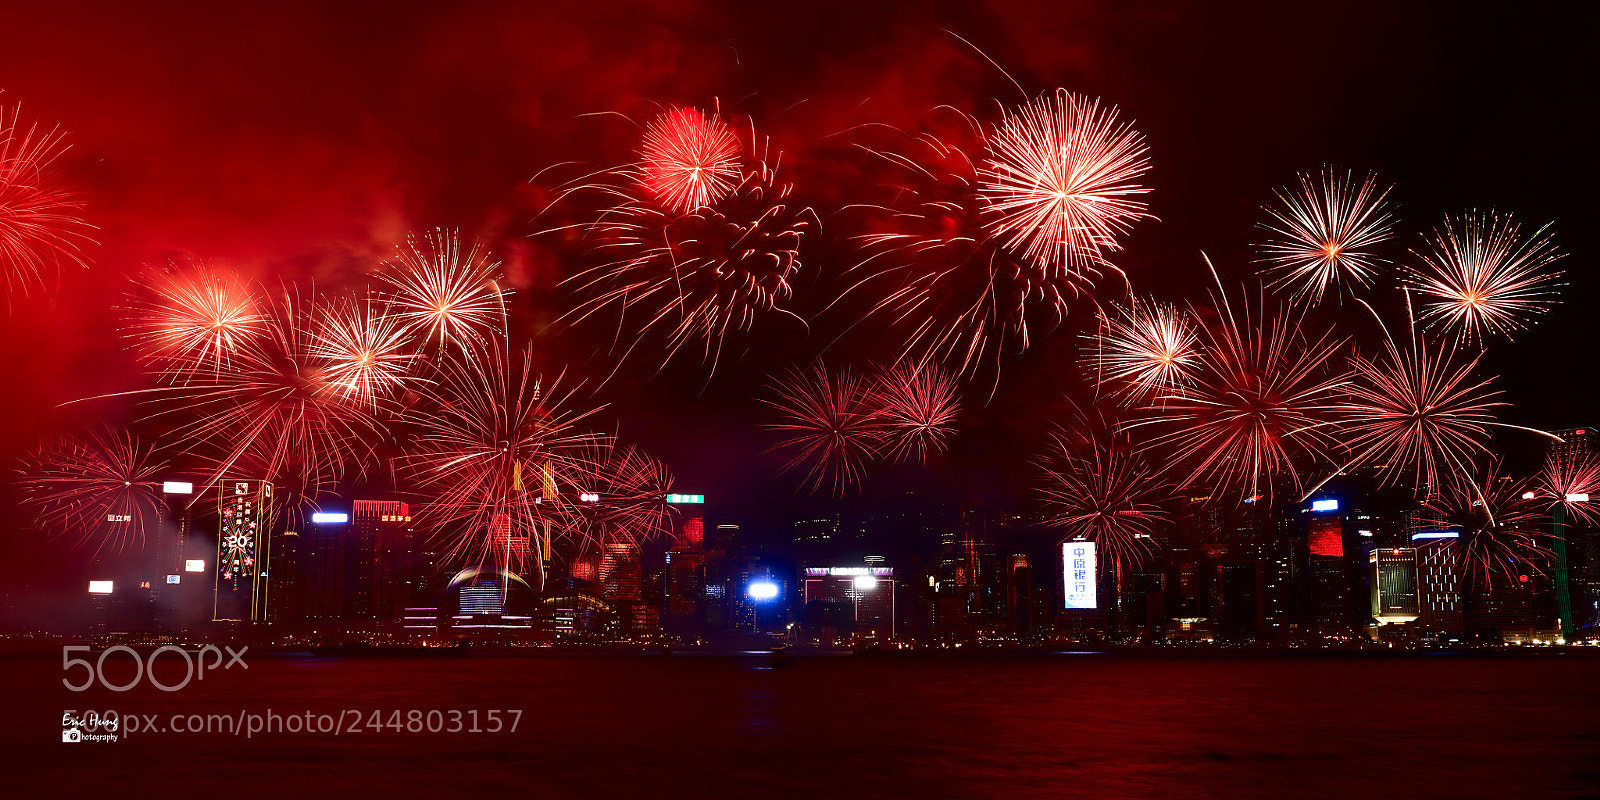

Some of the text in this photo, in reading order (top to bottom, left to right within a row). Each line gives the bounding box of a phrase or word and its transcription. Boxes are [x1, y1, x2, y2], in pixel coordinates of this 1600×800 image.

[228, 536, 247, 547] 20
[1073, 547, 1086, 593] 中原银行
